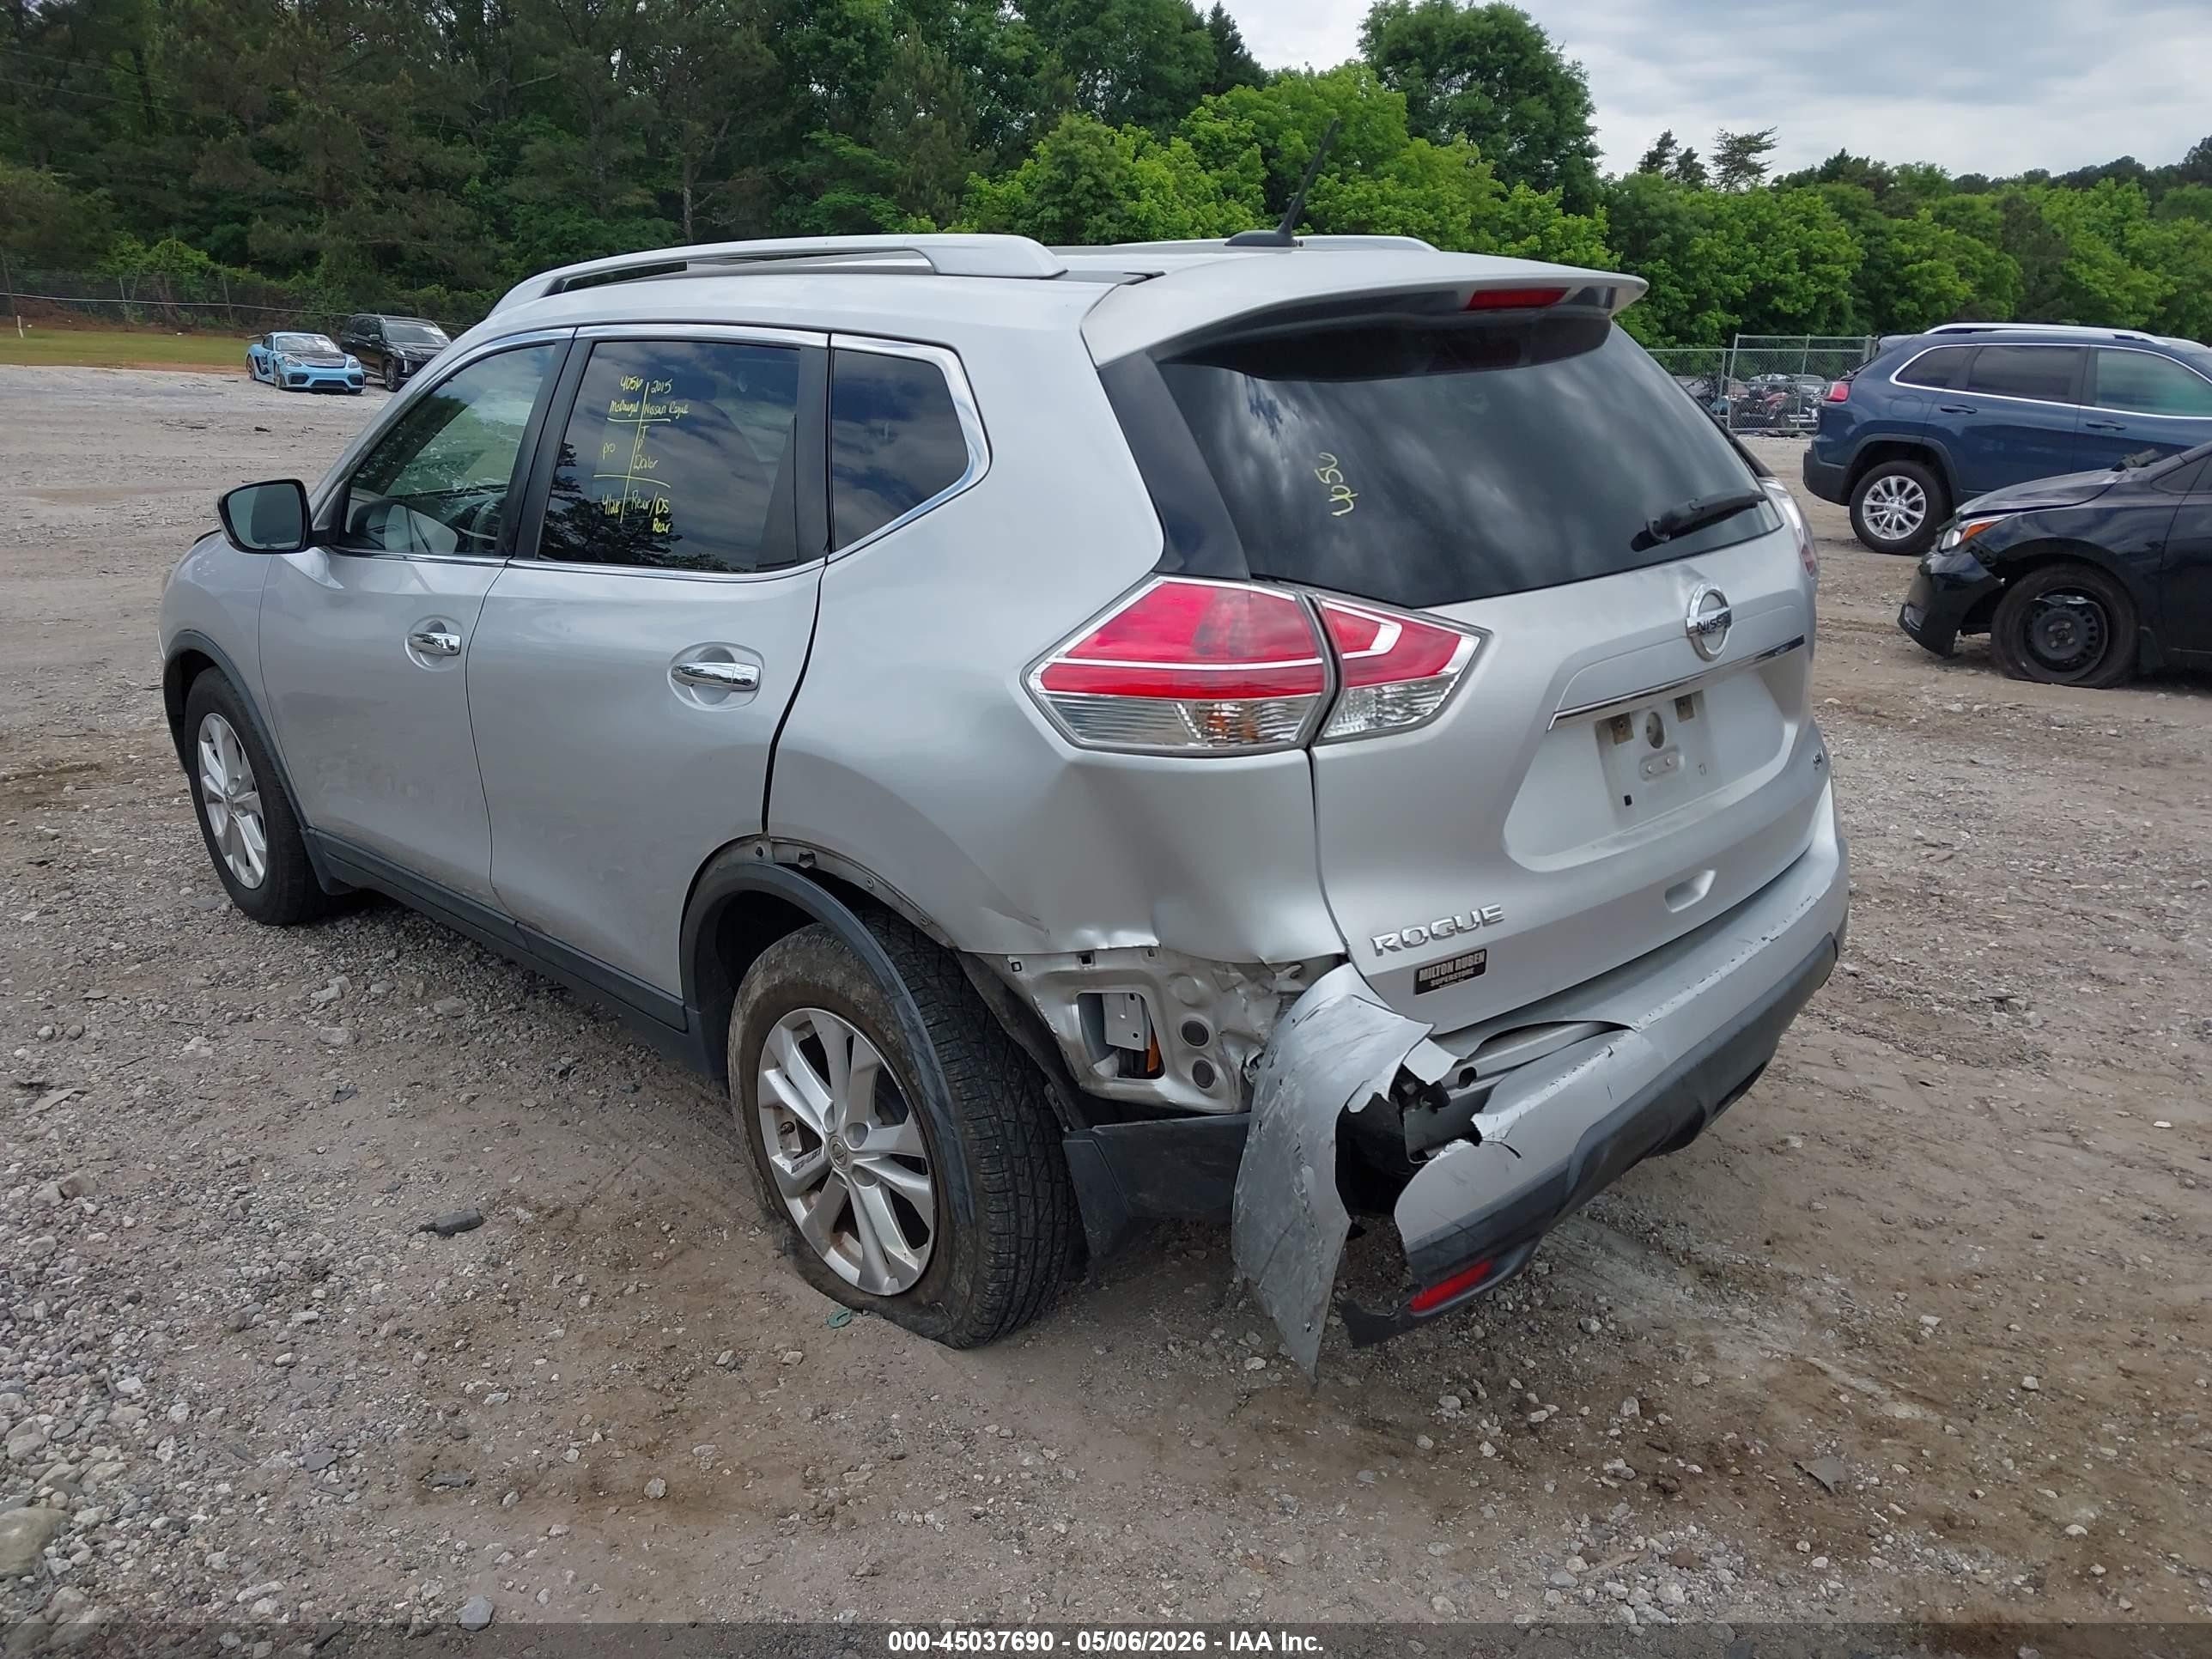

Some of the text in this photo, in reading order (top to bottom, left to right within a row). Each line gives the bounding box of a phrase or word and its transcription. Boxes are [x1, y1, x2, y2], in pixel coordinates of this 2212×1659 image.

[651, 378, 673, 394] 2015
[669, 400, 689, 420] Rogue
[653, 517, 672, 534] Rear
[1370, 902, 1505, 957] ROGUE
[1419, 959, 1455, 982] MILTON
[1430, 967, 1474, 988] SUPERSTORE
